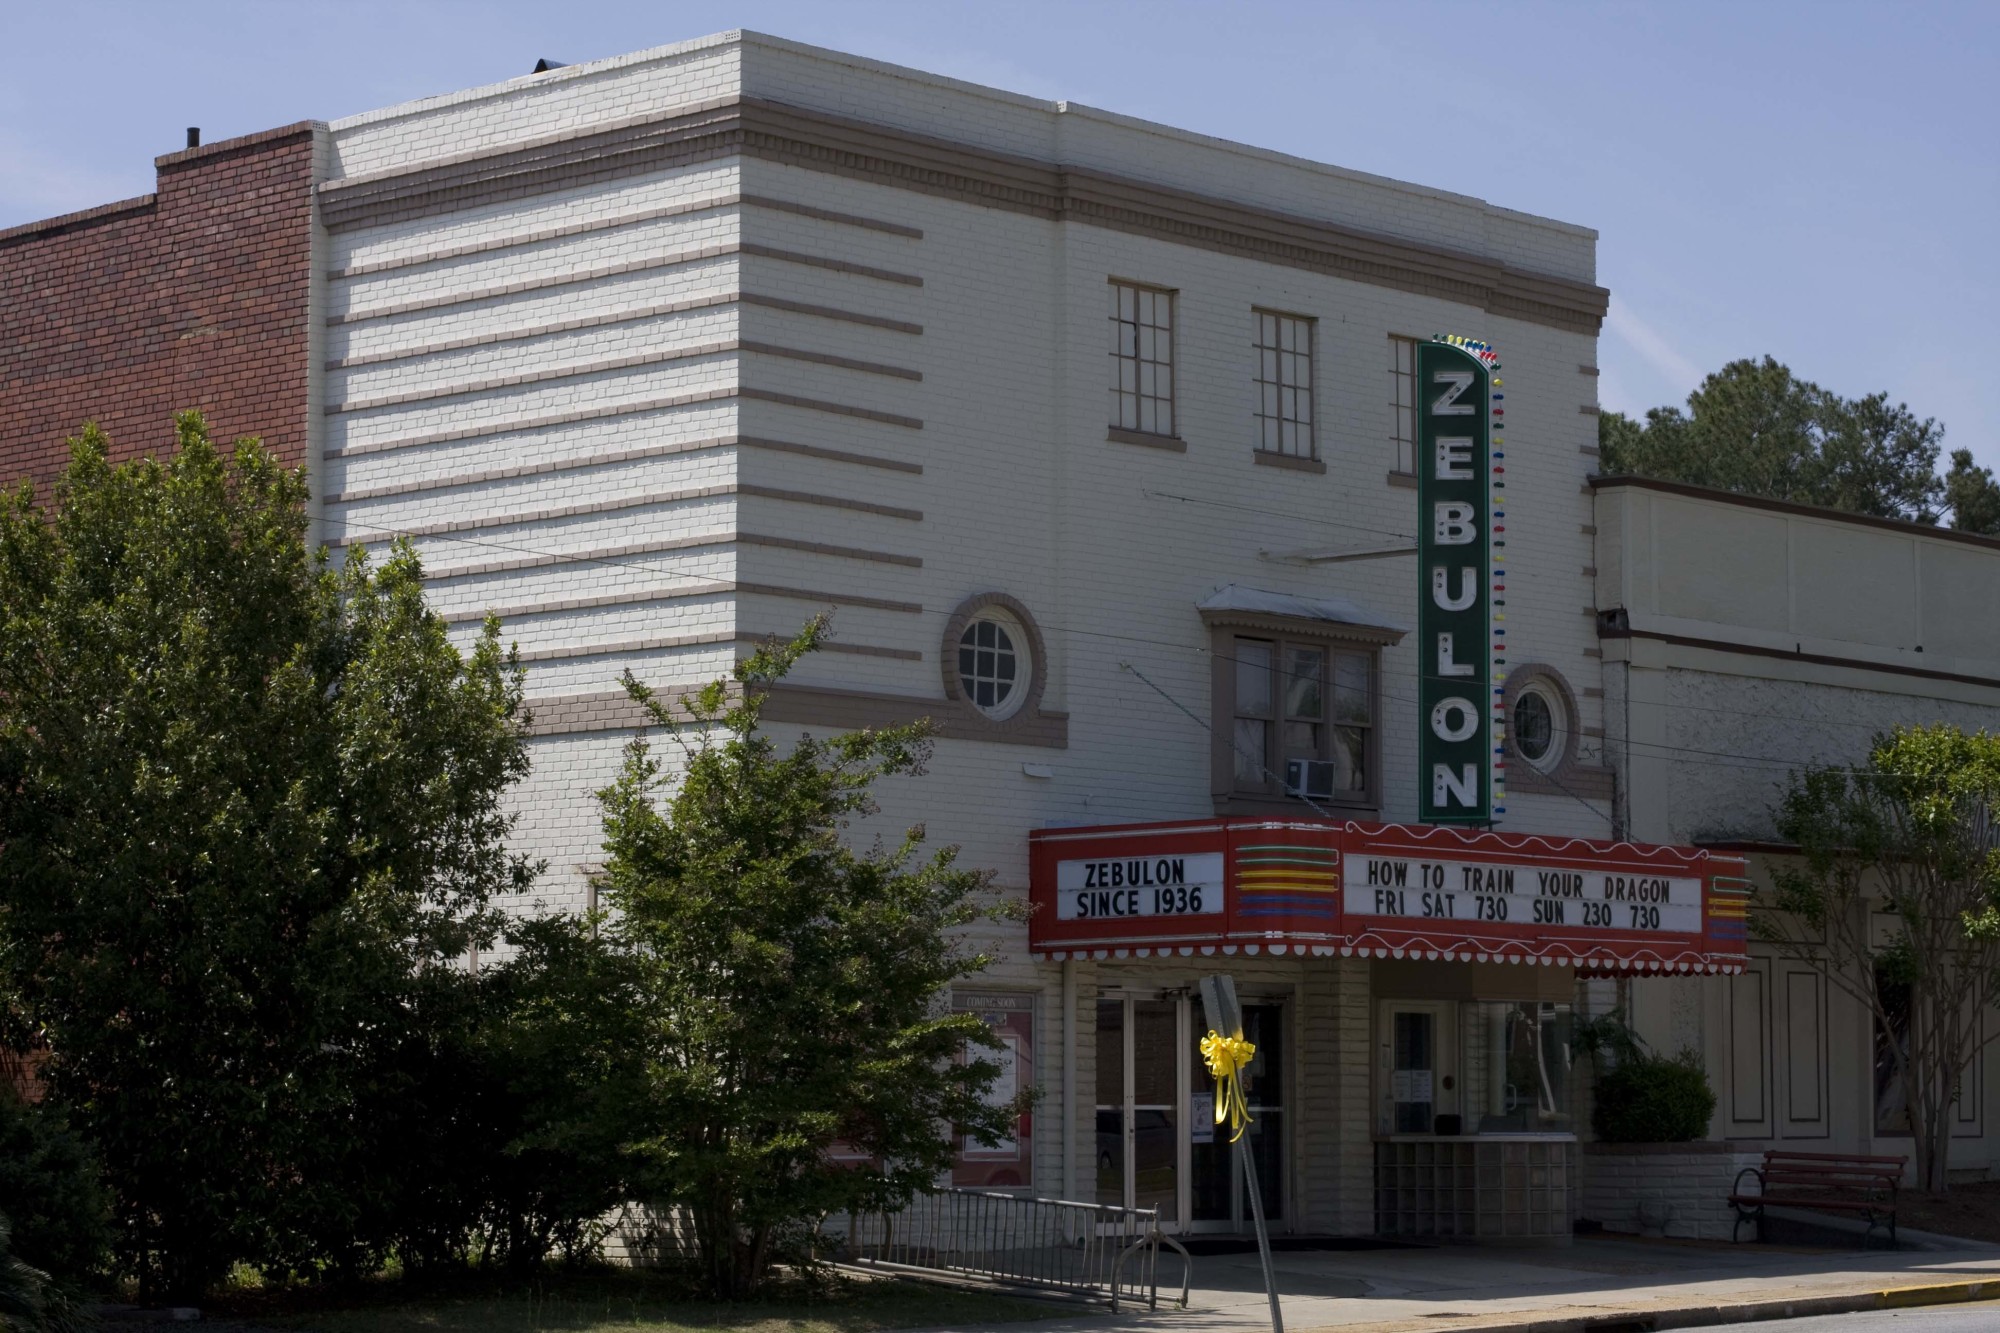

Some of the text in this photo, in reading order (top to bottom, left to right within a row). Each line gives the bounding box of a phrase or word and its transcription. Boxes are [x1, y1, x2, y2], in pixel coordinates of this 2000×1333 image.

[1431, 371, 1479, 807] ZEBULON
[1085, 859, 1184, 888] ZEBULON
[1368, 860, 1670, 903] HOW TO TRAIN YOUR DRAGON
[1077, 887, 1203, 917] SINCE 1936
[1375, 889, 1660, 929] FRI SAT 730 SUN 230 730
[966, 996, 1016, 1008] COMING SOON
